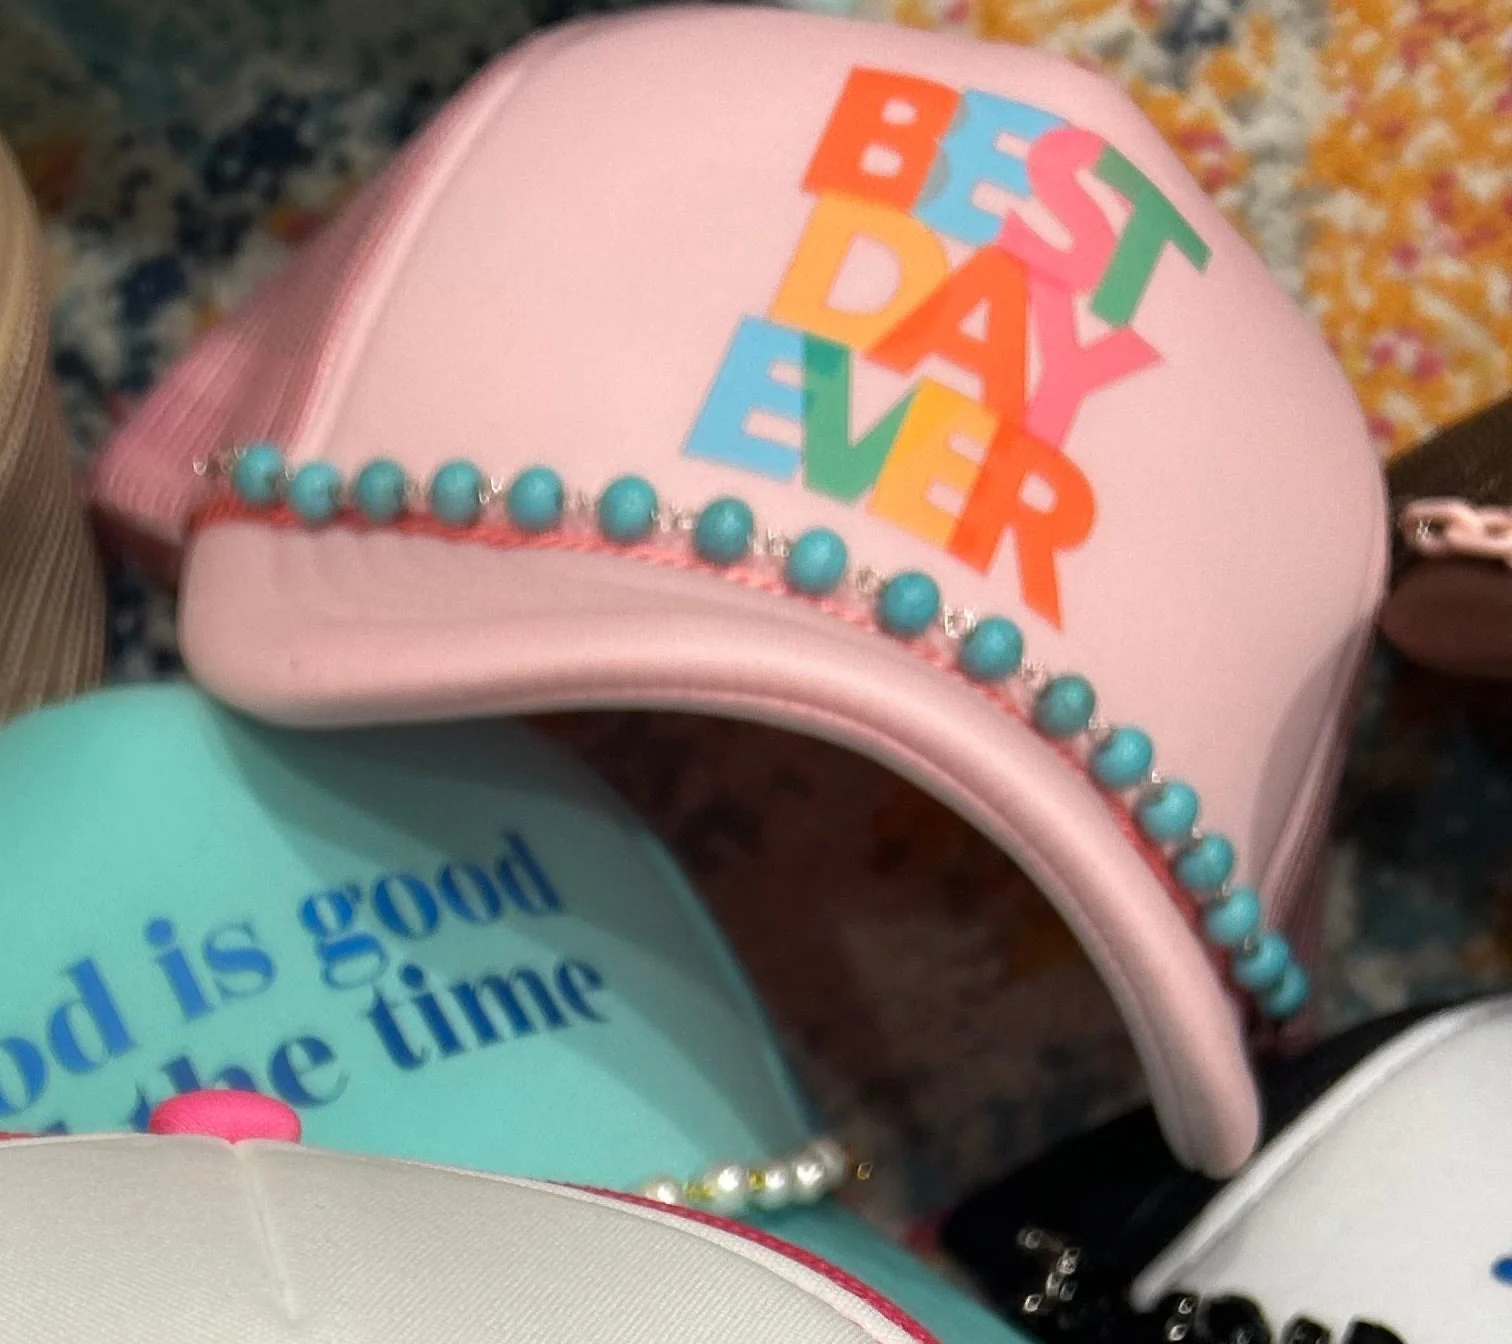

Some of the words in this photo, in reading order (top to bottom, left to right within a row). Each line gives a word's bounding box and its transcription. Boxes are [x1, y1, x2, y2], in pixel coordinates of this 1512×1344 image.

[767, 189, 1164, 452] DAY
[801, 66, 1212, 330] BEST
[680, 315, 1096, 632] EVER
[143, 916, 278, 1024] is
[297, 829, 566, 990] good
[365, 949, 610, 1073] time
